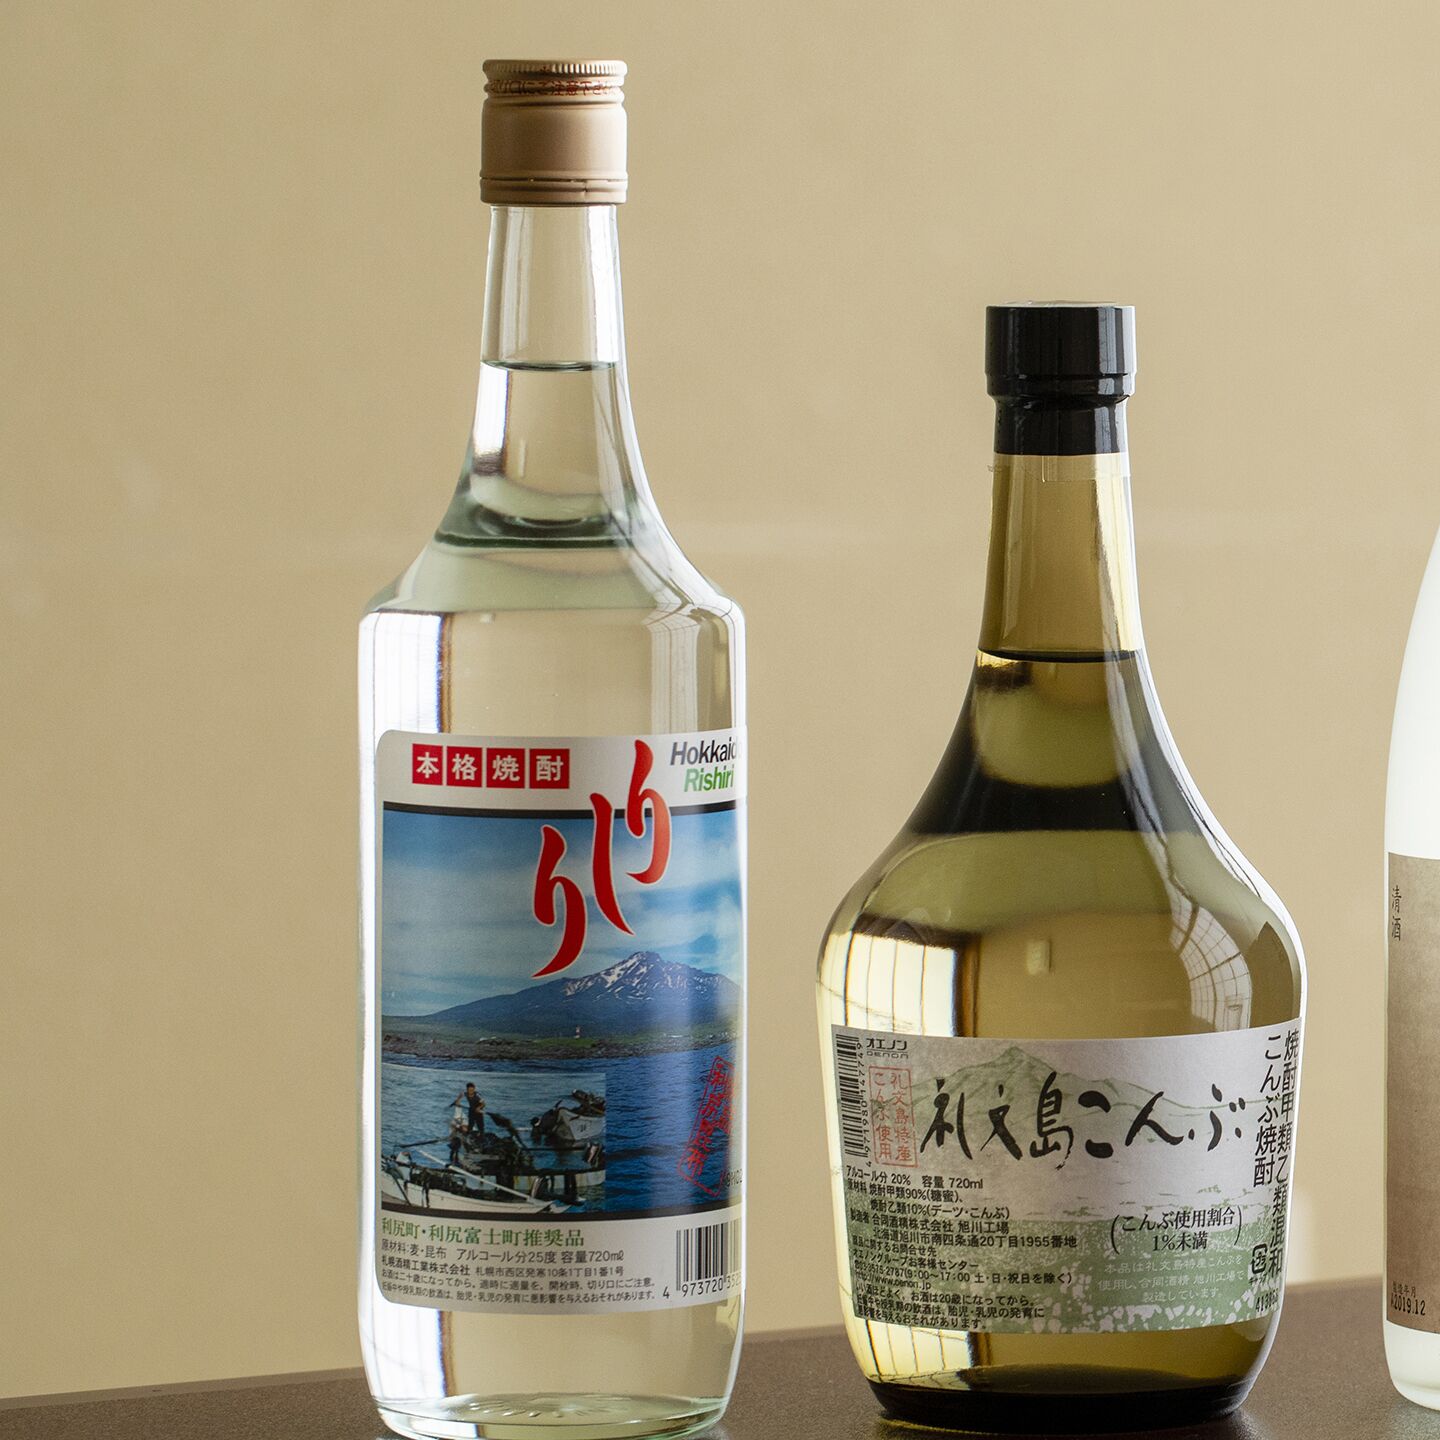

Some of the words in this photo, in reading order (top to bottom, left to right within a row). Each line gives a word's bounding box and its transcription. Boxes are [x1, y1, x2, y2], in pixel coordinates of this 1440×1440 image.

[416, 752, 563, 782] 本格焼酎
[684, 764, 734, 792] Rishiri
[532, 739, 672, 979] りしり
[1391, 884, 1402, 942] 清酒
[866, 1037, 908, 1051] オエノン
[890, 1072, 913, 1162] 礼文島特産
[920, 1071, 1246, 1170] 礼文島こんぶ
[1253, 1034, 1281, 1188] こんぶ焼酎
[1269, 1028, 1299, 1278] 焼酎甲類乙類混和
[846, 1165, 888, 1184] アルコール分
[891, 1173, 911, 1187] 20%
[922, 1175, 944, 1189] 容量
[949, 1177, 983, 1190] 720ml
[381, 1217, 584, 1247] 利尻町・利尻富士町推奨品
[872, 1214, 953, 1233] 合同酒精株式会社
[958, 1220, 1009, 1235] 旭川工場
[873, 1227, 1078, 1248] 北海道旭川市南四条通20丁目1955番地
[381, 1254, 470, 1276] 札幌酒精工業株式会社
[456, 1247, 556, 1265] アルコール分25度
